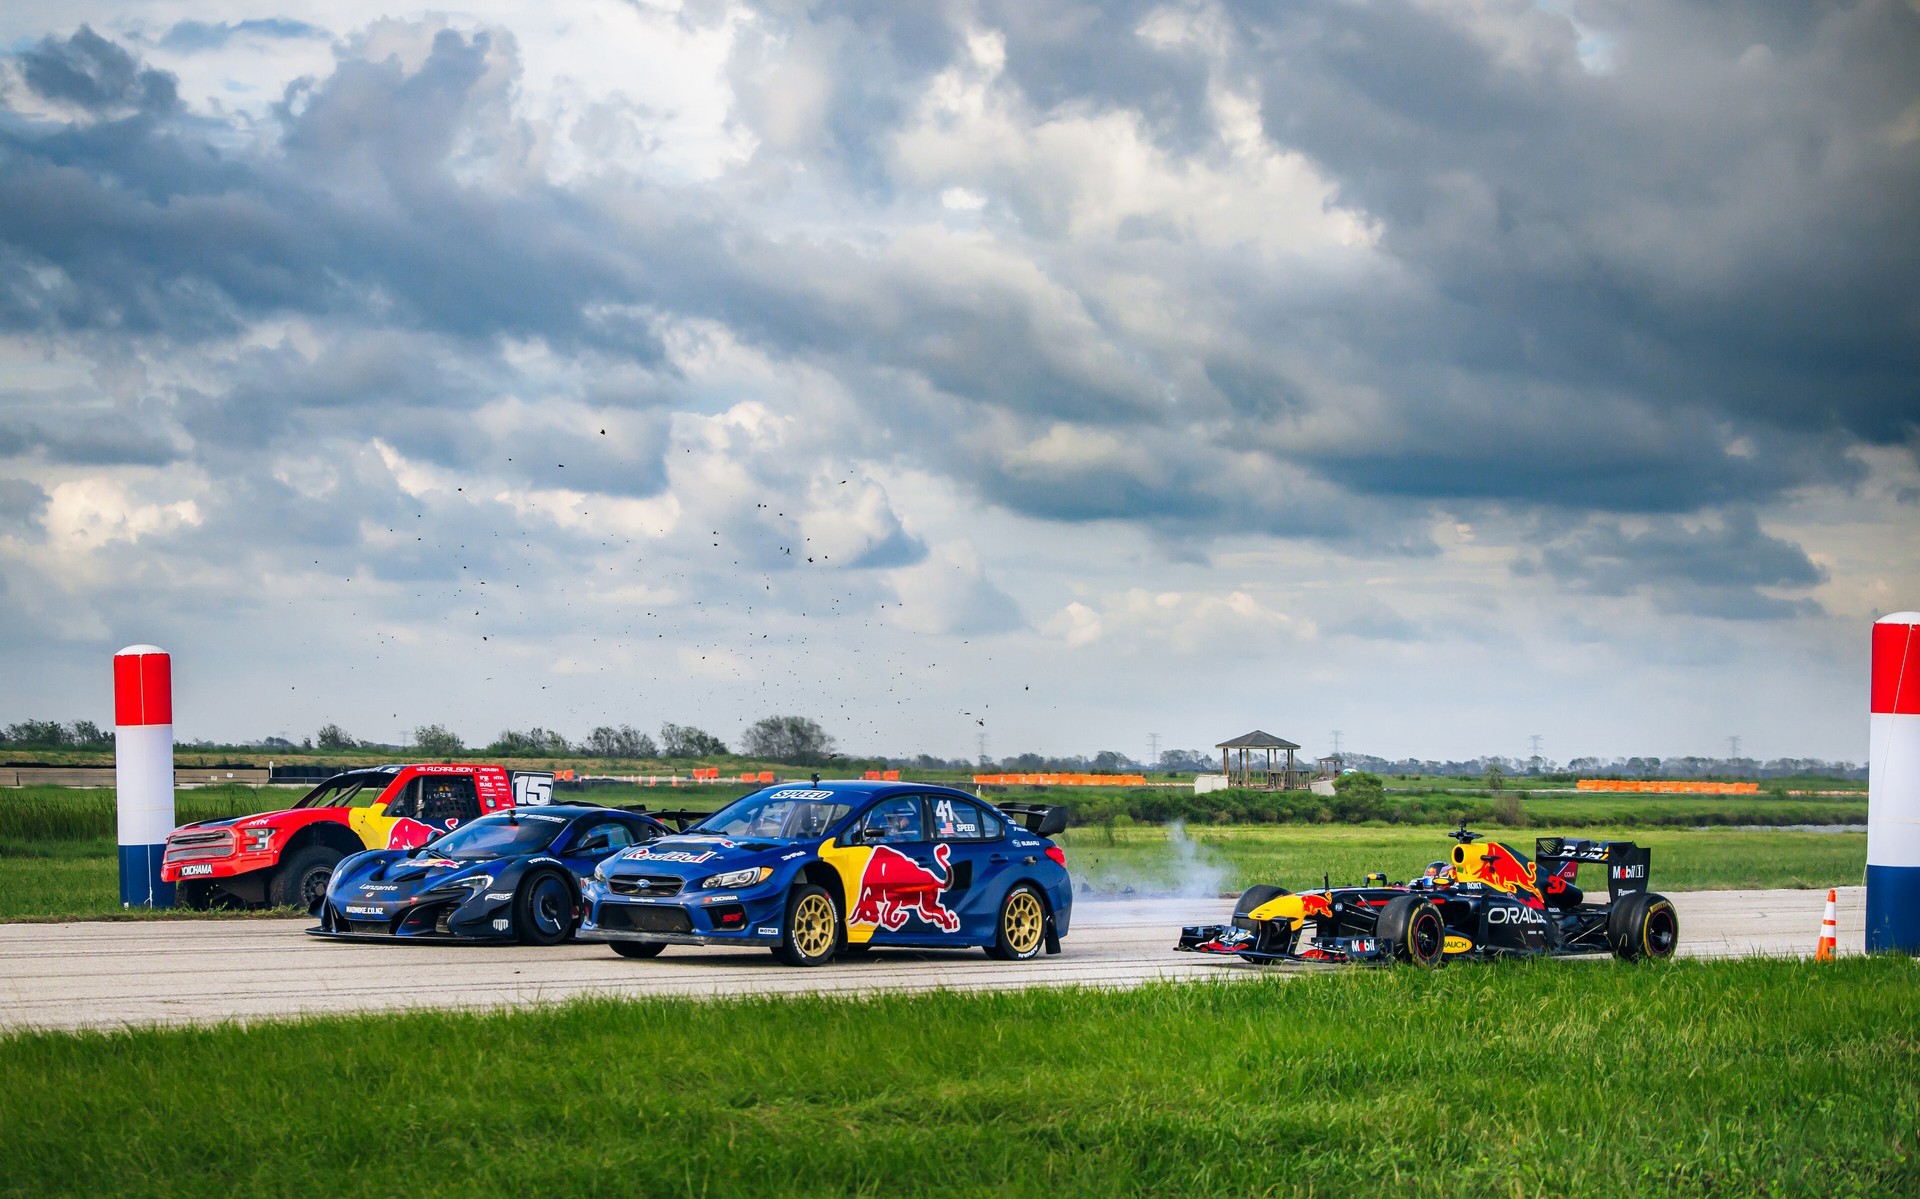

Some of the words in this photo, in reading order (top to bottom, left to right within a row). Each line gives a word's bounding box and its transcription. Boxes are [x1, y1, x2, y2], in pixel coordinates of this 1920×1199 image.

[514, 775, 551, 806] 15
[770, 789, 835, 800] SPEED
[935, 800, 954, 824] 41
[956, 823, 976, 832] SPEED
[181, 864, 213, 877] YOKOHAMA
[1612, 864, 1635, 879] Mobil
[358, 883, 399, 891] Lanzante
[1466, 881, 1483, 890] ROKT
[1350, 939, 1376, 953] Mobil
